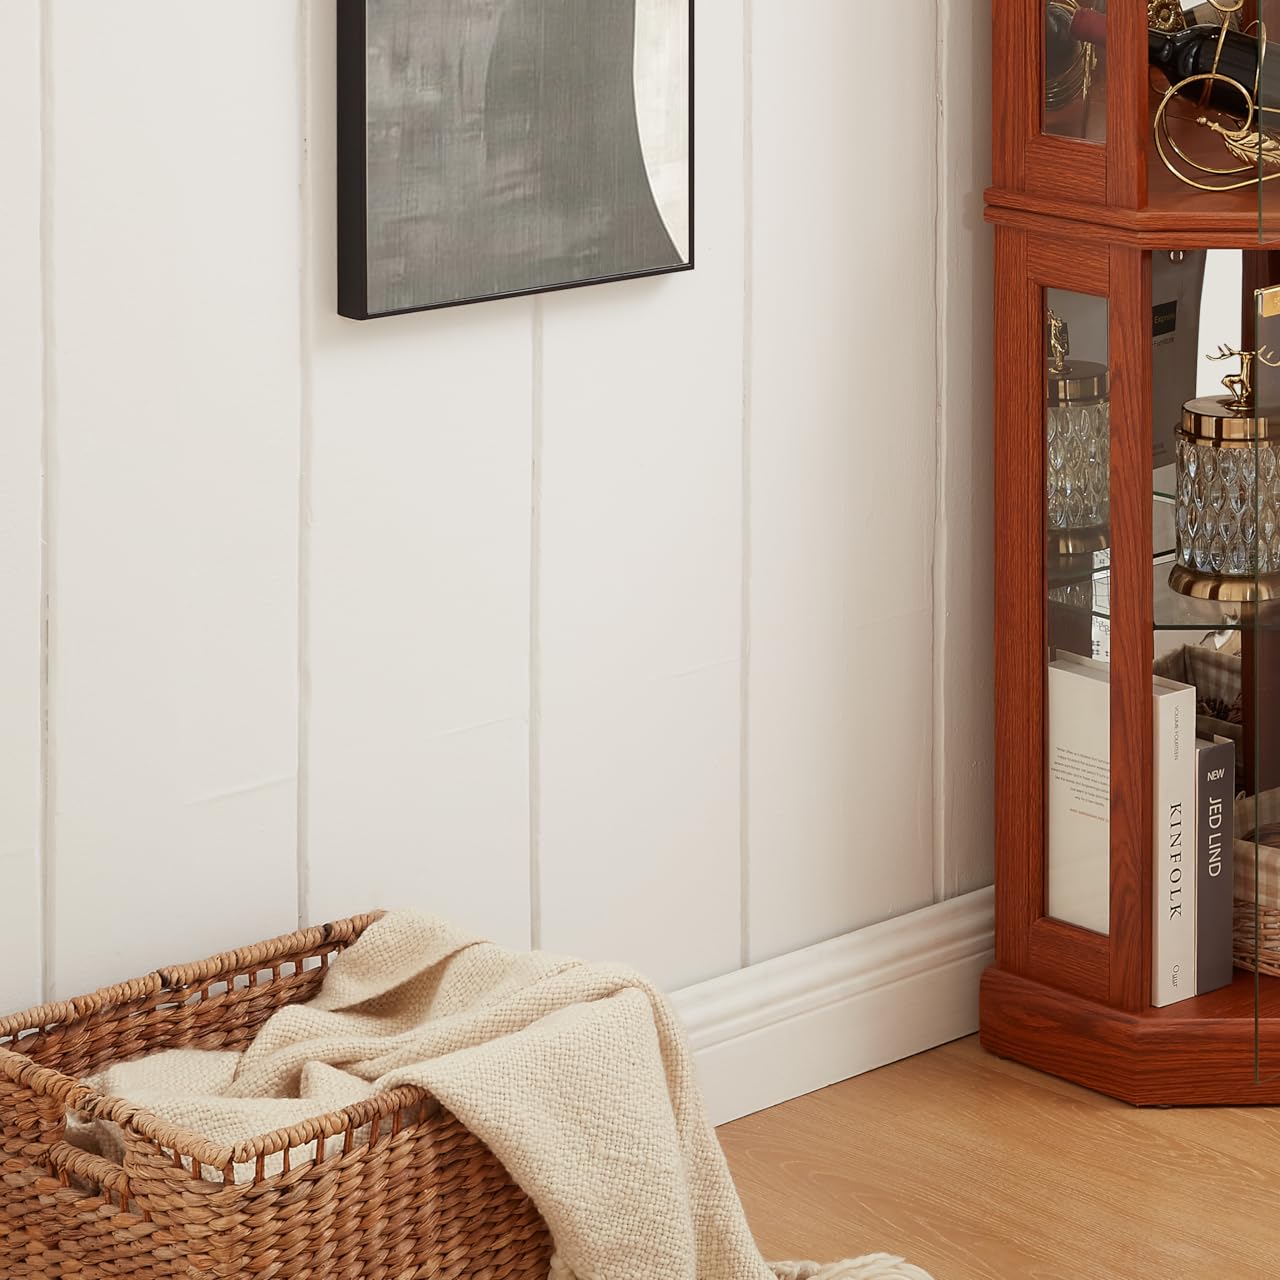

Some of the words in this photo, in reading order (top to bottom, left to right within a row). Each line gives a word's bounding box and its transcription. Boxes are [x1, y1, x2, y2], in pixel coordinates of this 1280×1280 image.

[1207, 767, 1226, 782] NEW
[1208, 797, 1222, 829] JED
[1169, 802, 1182, 921] KINFOLK
[1208, 832, 1222, 877] LIND
